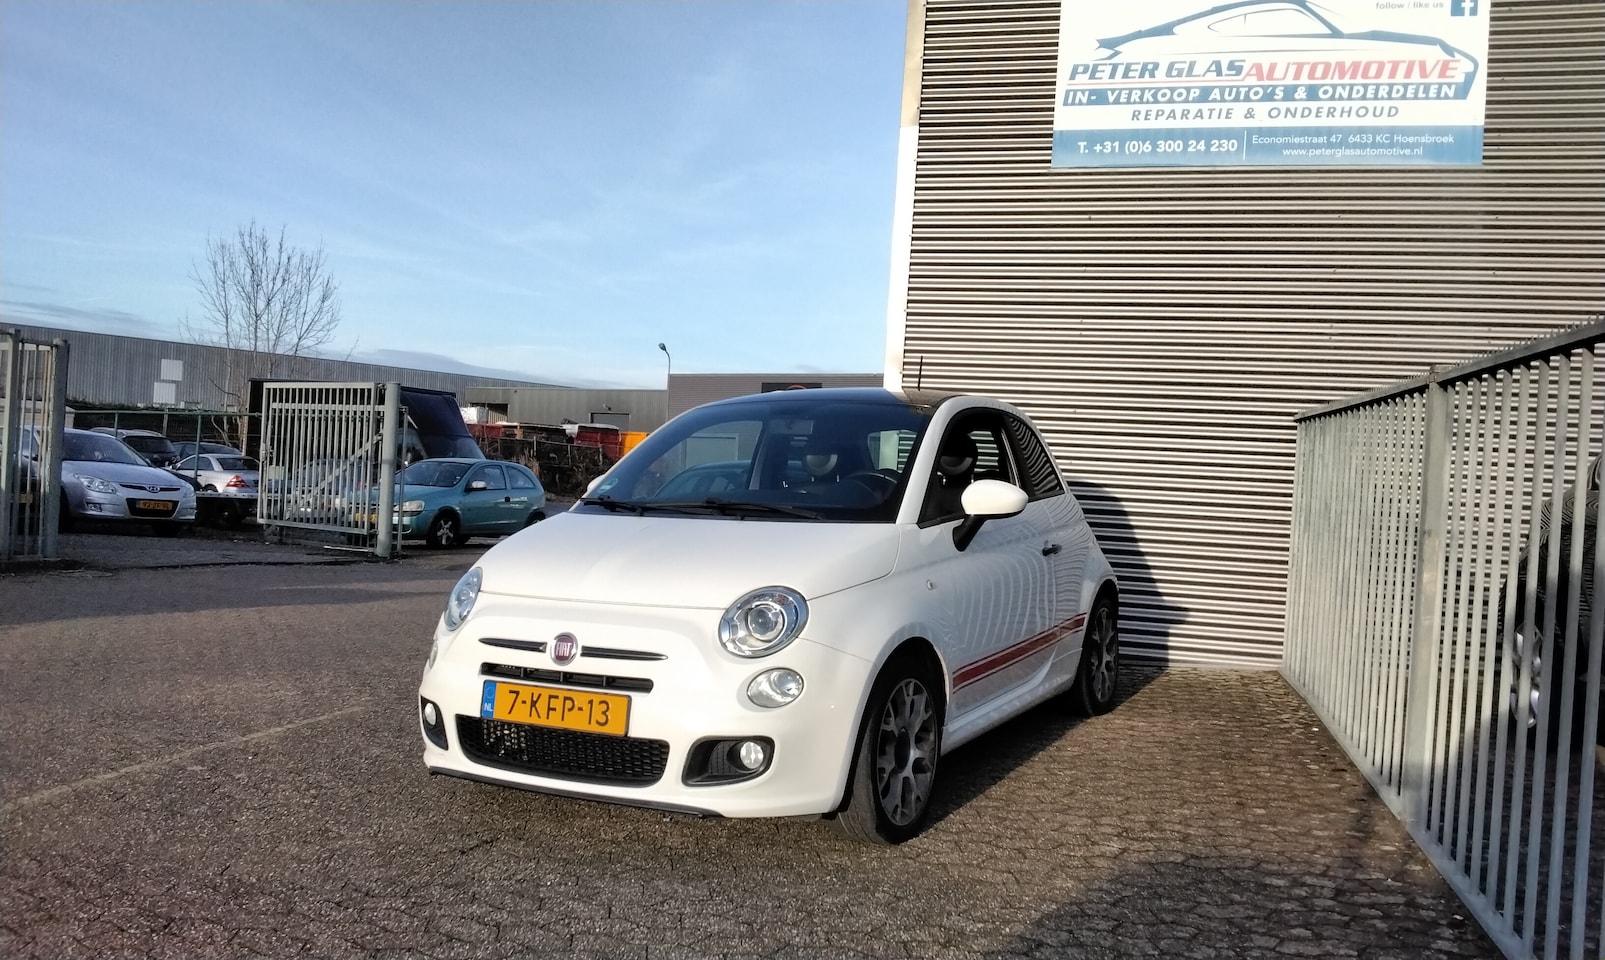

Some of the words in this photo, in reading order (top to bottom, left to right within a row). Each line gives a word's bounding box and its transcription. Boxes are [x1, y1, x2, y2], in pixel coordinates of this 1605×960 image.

[1375, 1, 1405, 9] follow
[1413, 1, 1430, 9] like
[1068, 61, 1160, 81] PETER
[1067, 89, 1097, 104] IN-
[1107, 88, 1200, 103] VERKOOP
[1208, 86, 1284, 101] AUTO'S
[1294, 86, 1307, 99] &
[1318, 84, 1456, 99] ONDERDELEN
[1131, 107, 1234, 121] REPARATIE
[1243, 107, 1256, 120] &
[1267, 105, 1399, 119] ONDERHOUD
[1252, 134, 1327, 144] Economiestraat
[1330, 134, 1342, 144] 47
[1347, 133, 1373, 144] 6433
[1376, 133, 1391, 143] KC
[1394, 133, 1454, 143] Hoensbroek
[1077, 141, 1089, 153] T.
[1093, 141, 1119, 153] +31
[1125, 140, 1152, 155] (0)6
[1156, 140, 1183, 152] 300
[1187, 140, 1206, 152] 24
[1210, 139, 1238, 152] 230
[1282, 146, 1423, 158] www.peterglasautomotive.nl
[555, 641, 573, 657] FIAT
[483, 702, 494, 712] NL
[507, 689, 611, 727] 7-KFP-13
